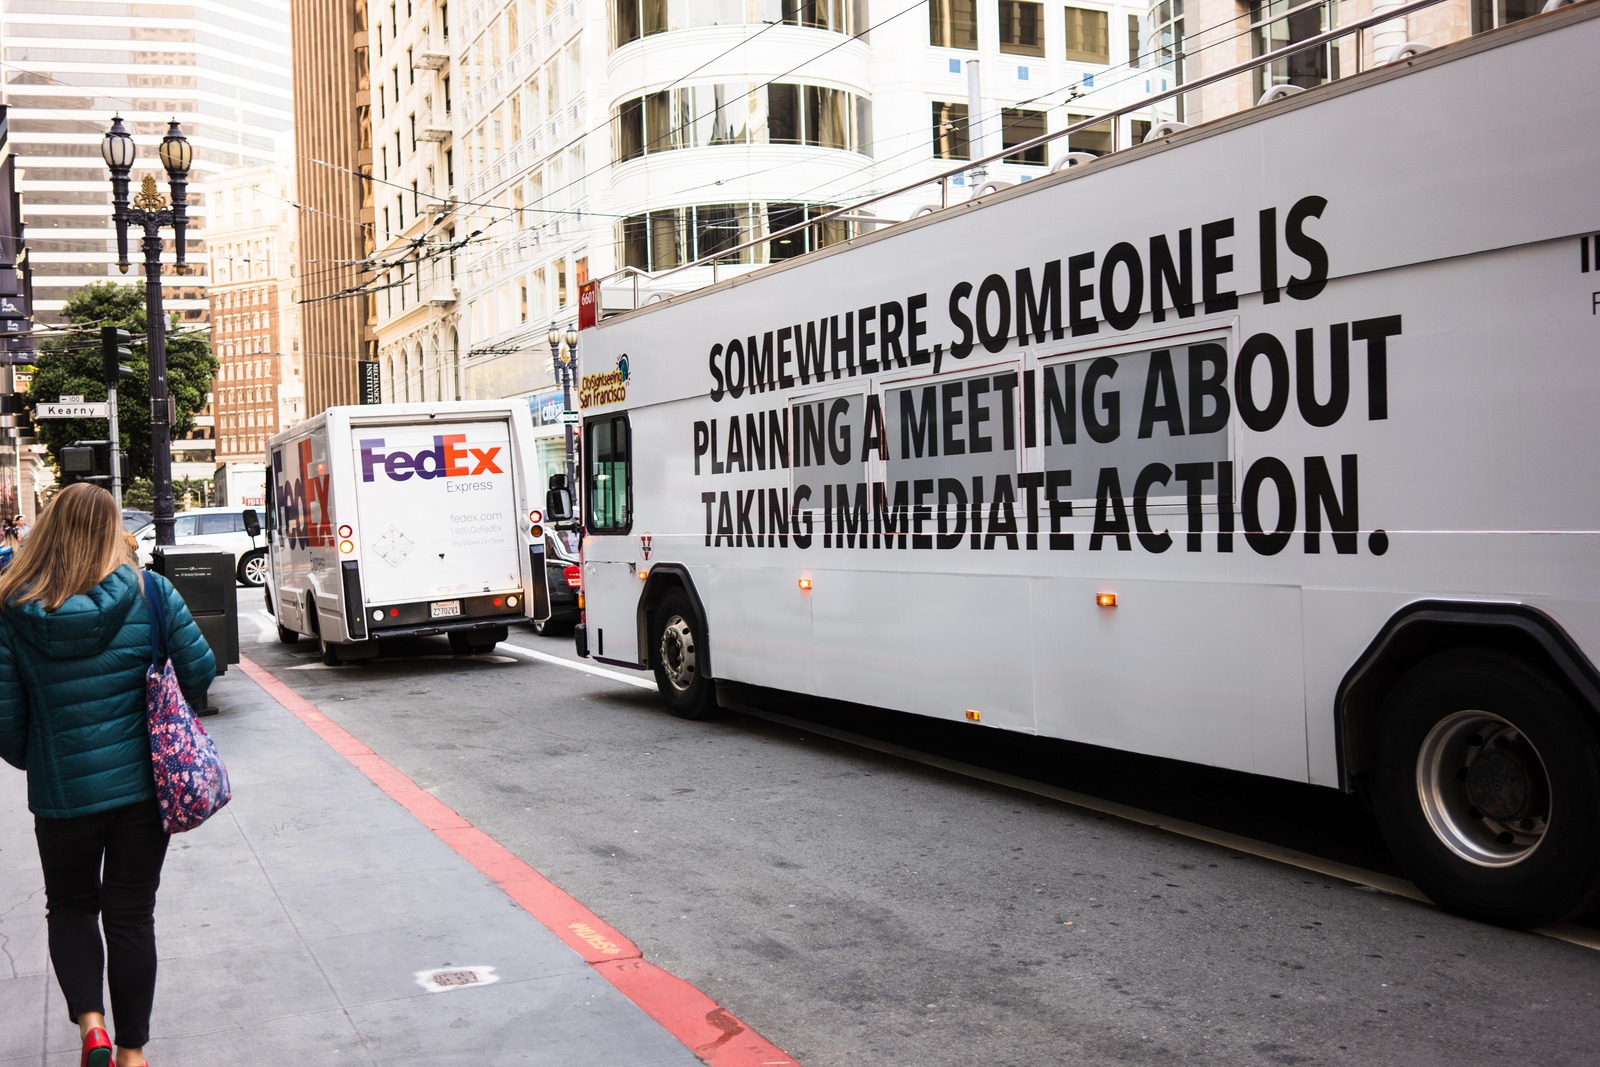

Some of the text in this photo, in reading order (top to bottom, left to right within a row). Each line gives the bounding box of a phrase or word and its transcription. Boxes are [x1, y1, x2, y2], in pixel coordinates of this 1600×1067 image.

[581, 290, 595, 305] 6601
[709, 195, 1329, 403] SOMEWHERE, SOMEONE IS
[366, 363, 374, 404] INSTITUTE
[580, 386, 627, 410] San Francisco
[693, 313, 1403, 476] PLANNING A MEETING ABOUT
[48, 406, 95, 416] Kearny
[359, 433, 505, 483] FedEx
[273, 438, 336, 551] FedEx
[446, 480, 494, 494] Express
[701, 453, 1389, 557] TAKING IMMEDIATE ACTION.
[450, 512, 503, 524] fedex.com
